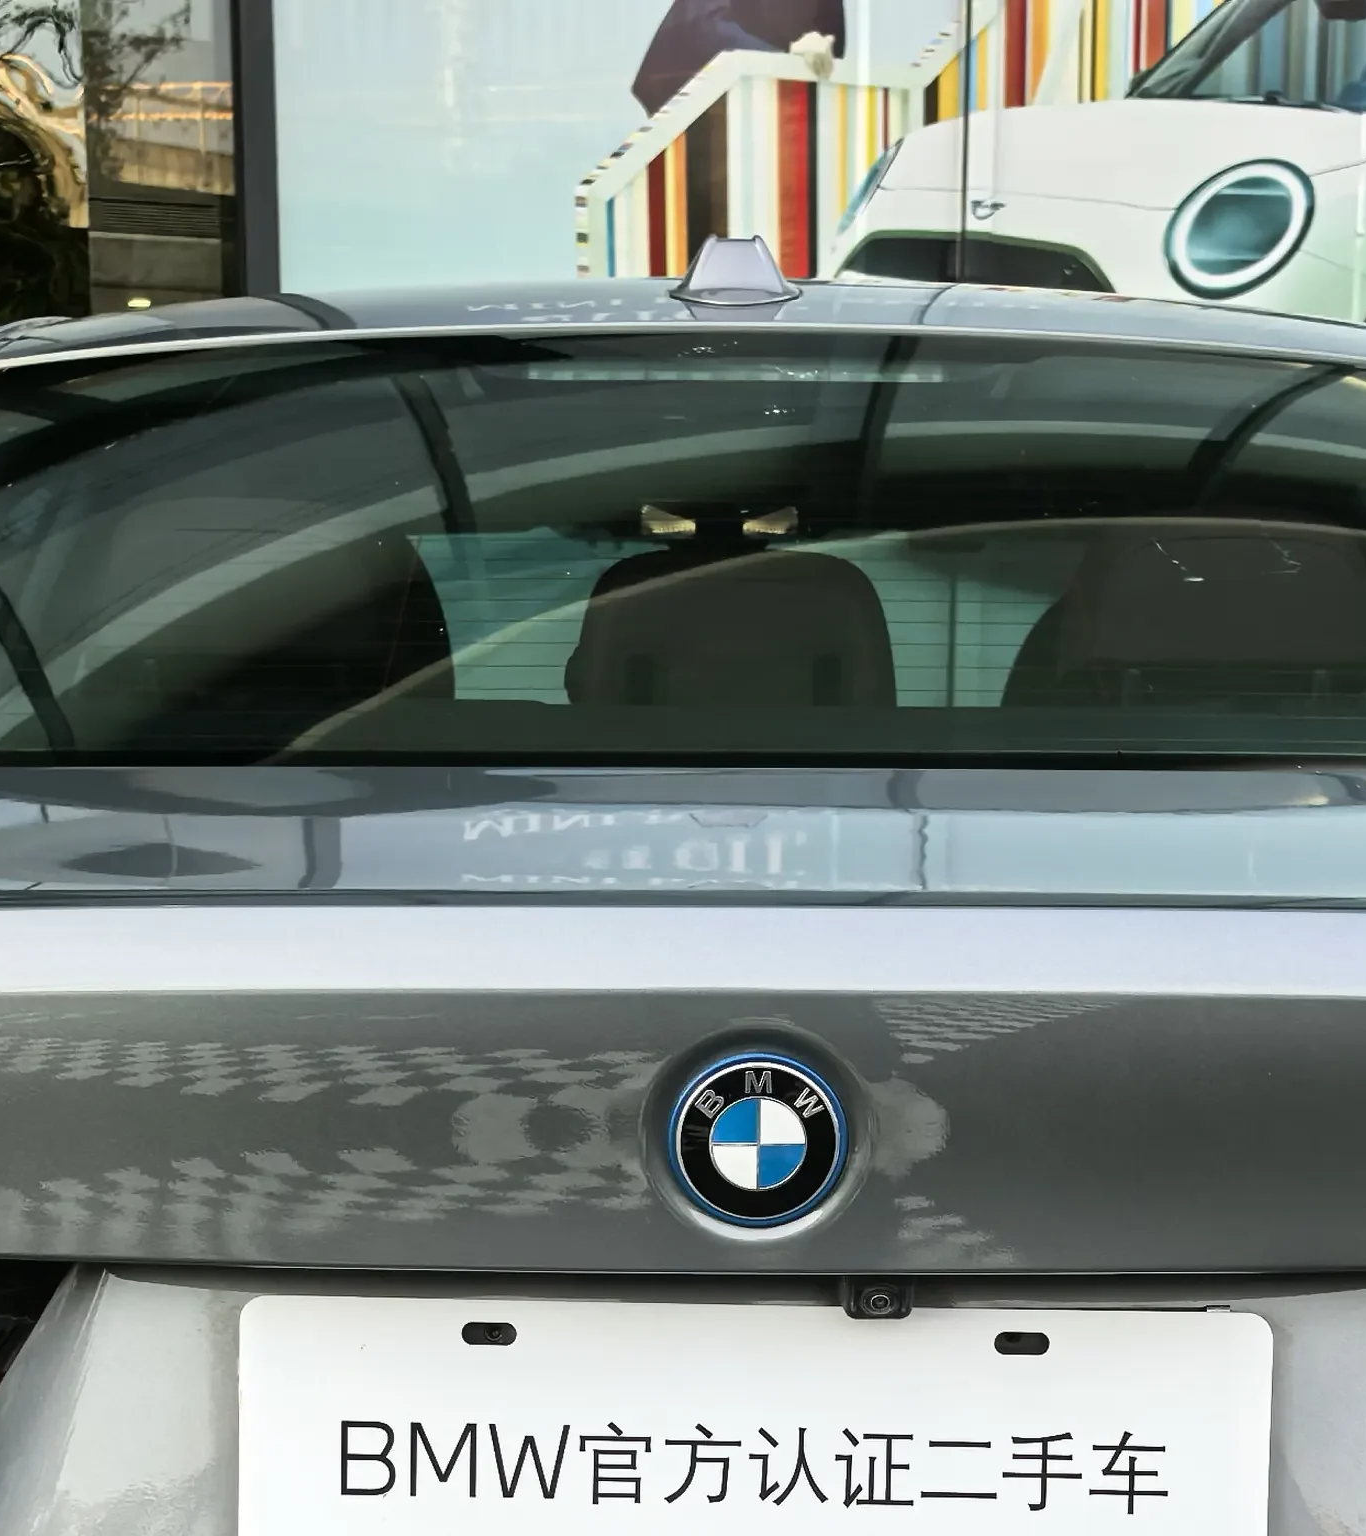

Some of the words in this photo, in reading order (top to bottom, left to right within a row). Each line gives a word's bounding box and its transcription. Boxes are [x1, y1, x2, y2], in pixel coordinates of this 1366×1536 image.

[695, 1070, 825, 1119] BMW
[338, 1419, 1171, 1517] BMW官方认证二手车
